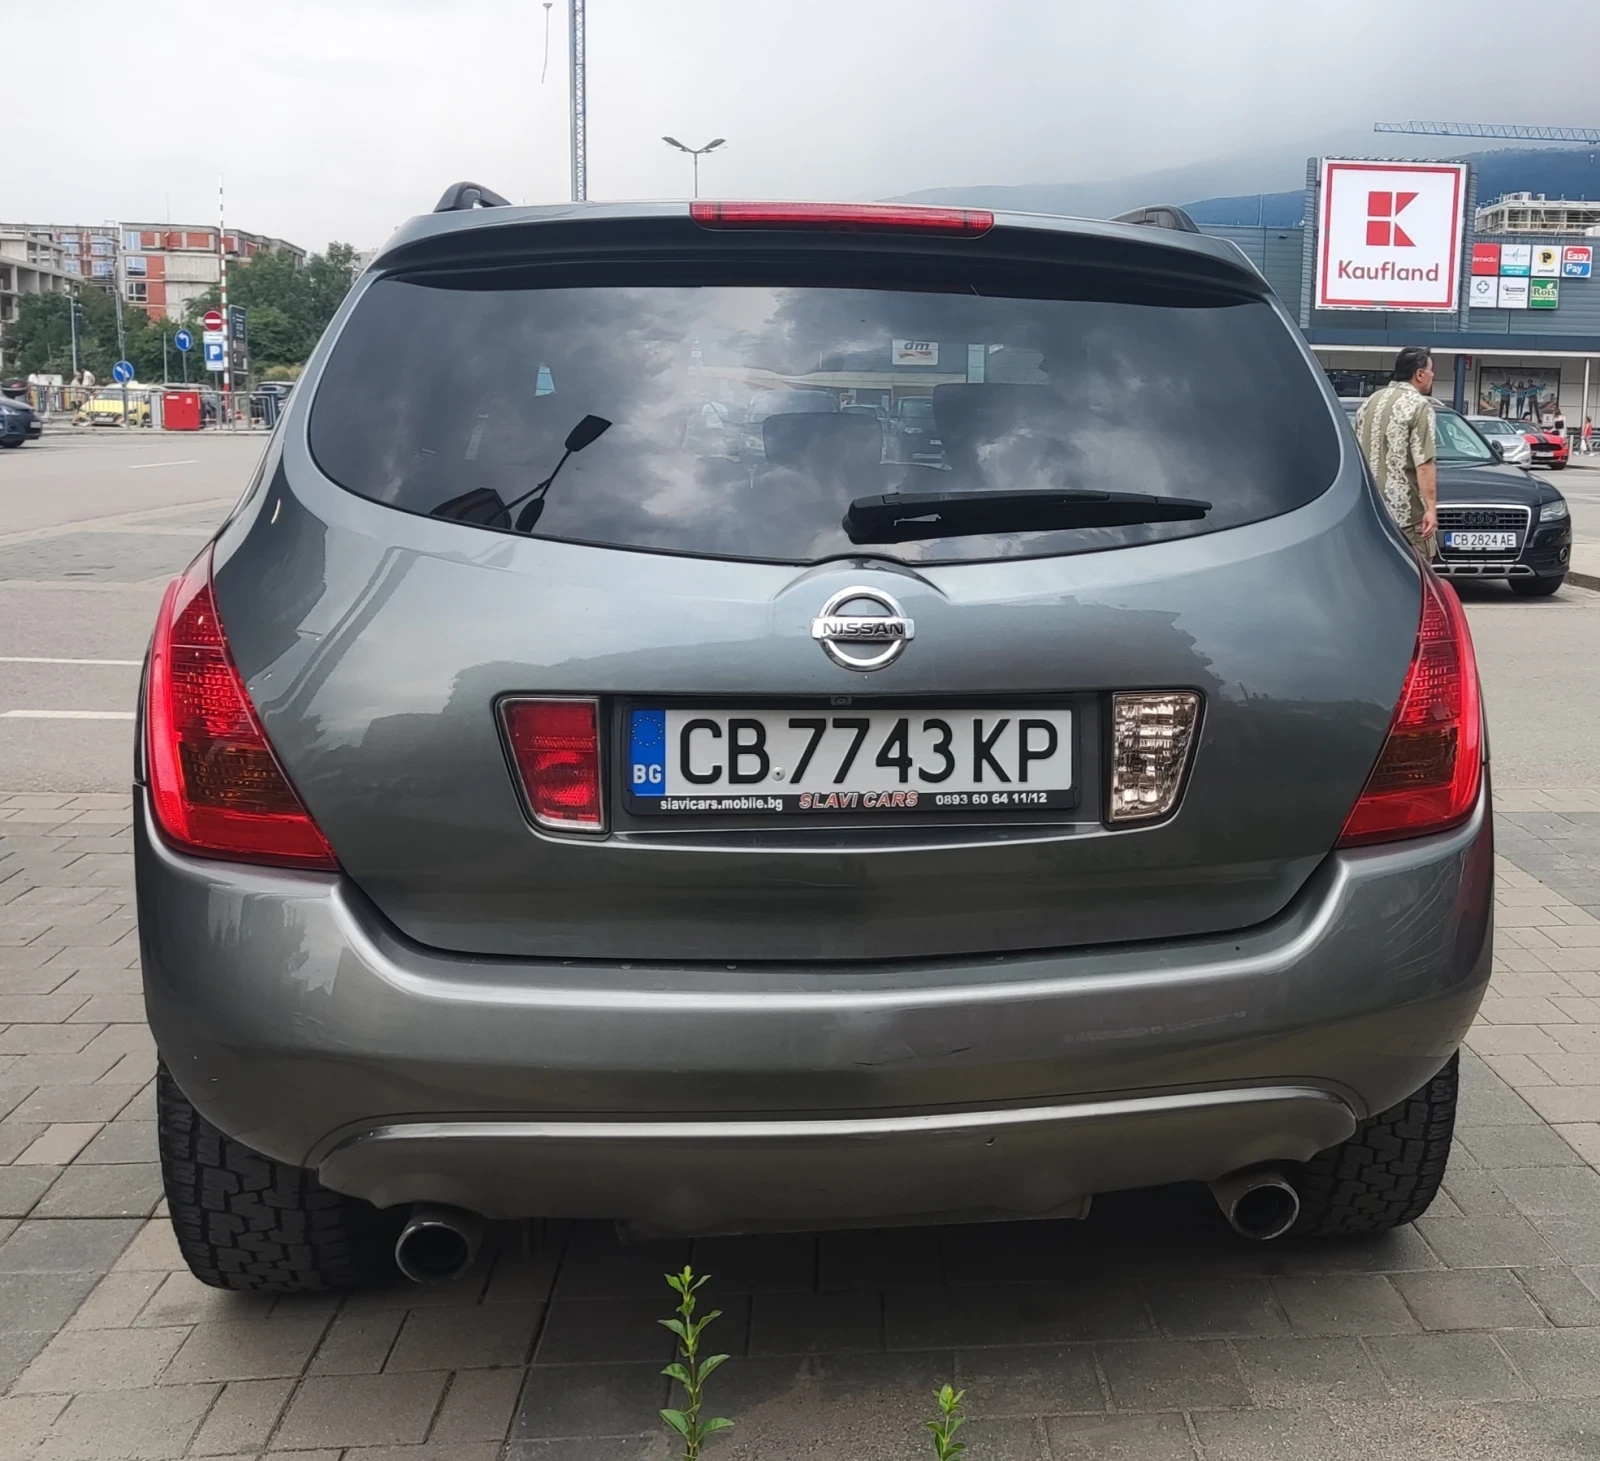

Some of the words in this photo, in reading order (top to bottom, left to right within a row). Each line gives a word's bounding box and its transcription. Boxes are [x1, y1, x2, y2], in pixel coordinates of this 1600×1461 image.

[1567, 251, 1588, 262] Easy
[1338, 260, 1439, 282] Kaufland
[1566, 264, 1583, 274] Pay
[904, 340, 930, 351] dm
[1454, 534, 1468, 546] CB
[1471, 534, 1497, 546] 2824
[1500, 534, 1514, 546] AE
[823, 621, 904, 635] NISSAN
[679, 718, 771, 785] CB
[788, 718, 955, 785] 7743
[972, 718, 1059, 784] KP
[632, 764, 662, 784] BG
[660, 796, 783, 812] slavicars.mobile.bg
[798, 792, 859, 809] SLAVI
[862, 791, 919, 808] CARS
[935, 794, 968, 806] 0893
[971, 794, 988, 805] 60
[991, 793, 1008, 805] 64
[1011, 792, 1047, 804] 11/12
